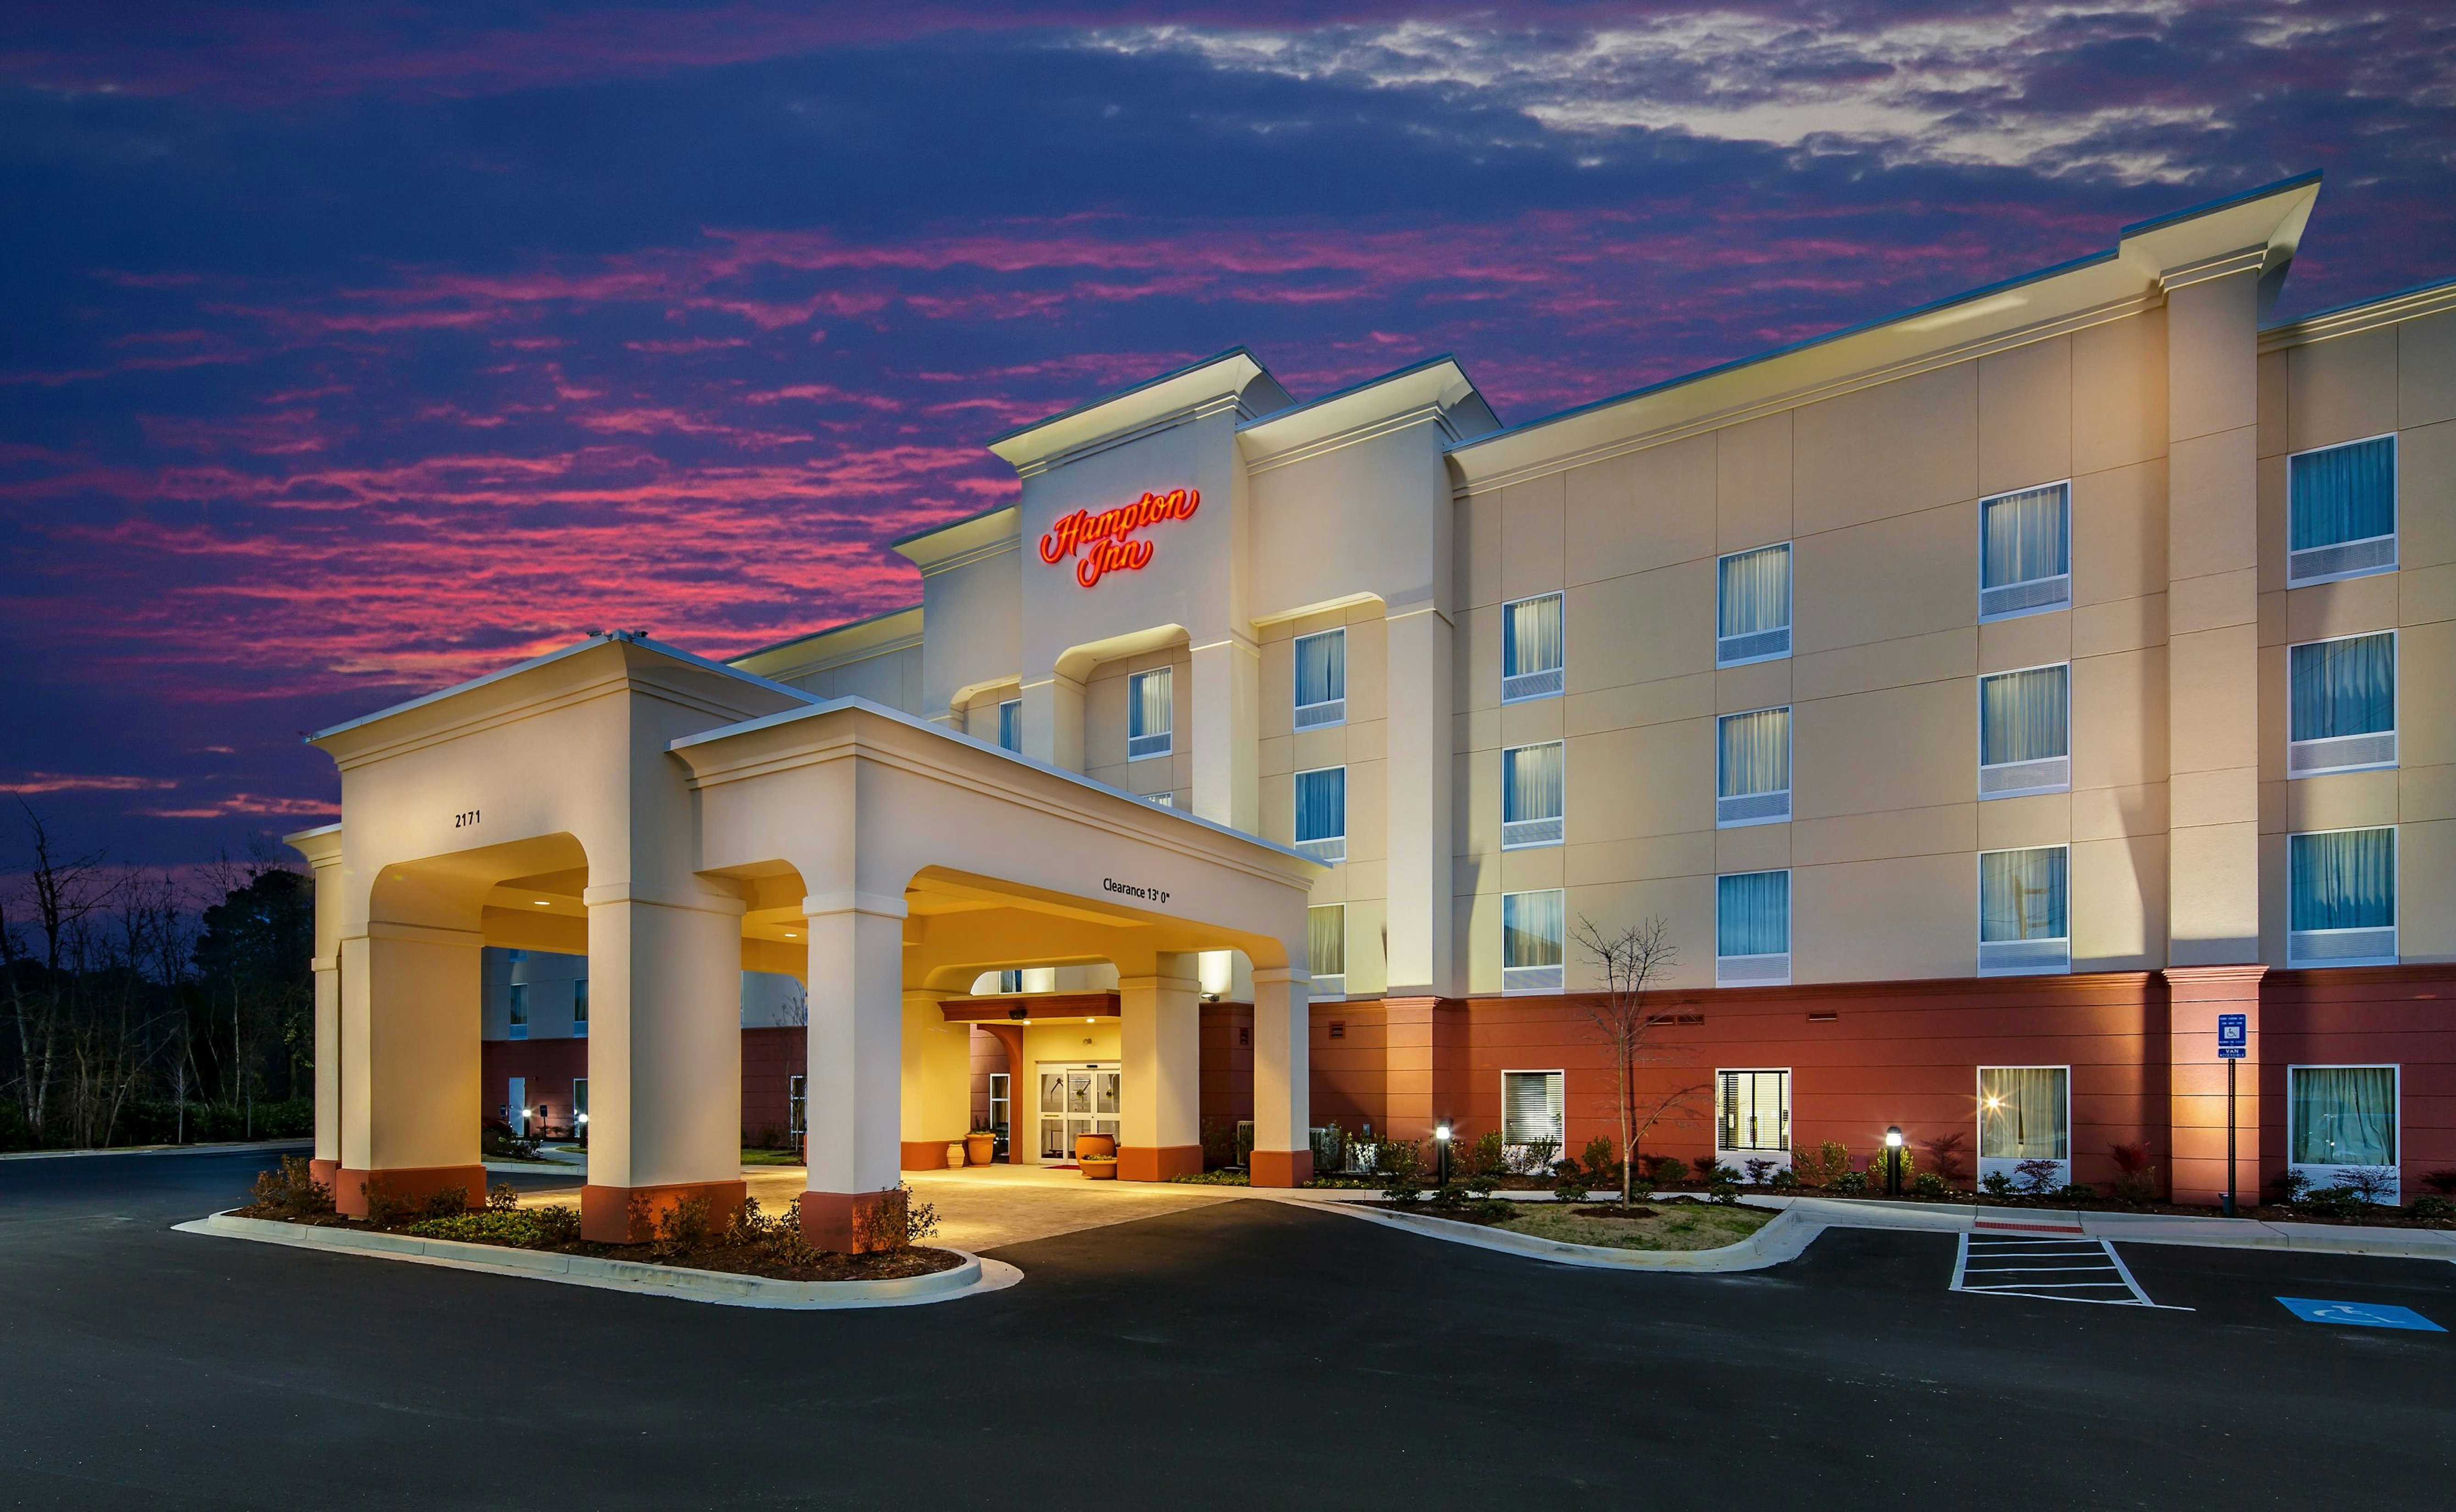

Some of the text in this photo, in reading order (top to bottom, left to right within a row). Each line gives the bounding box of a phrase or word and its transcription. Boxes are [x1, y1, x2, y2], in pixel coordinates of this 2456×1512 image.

[1041, 489, 1200, 564] Hampton
[1077, 538, 1153, 587] Inn
[456, 809, 480, 828] 2171
[1104, 878, 1170, 903] Clearance 13' 0"
